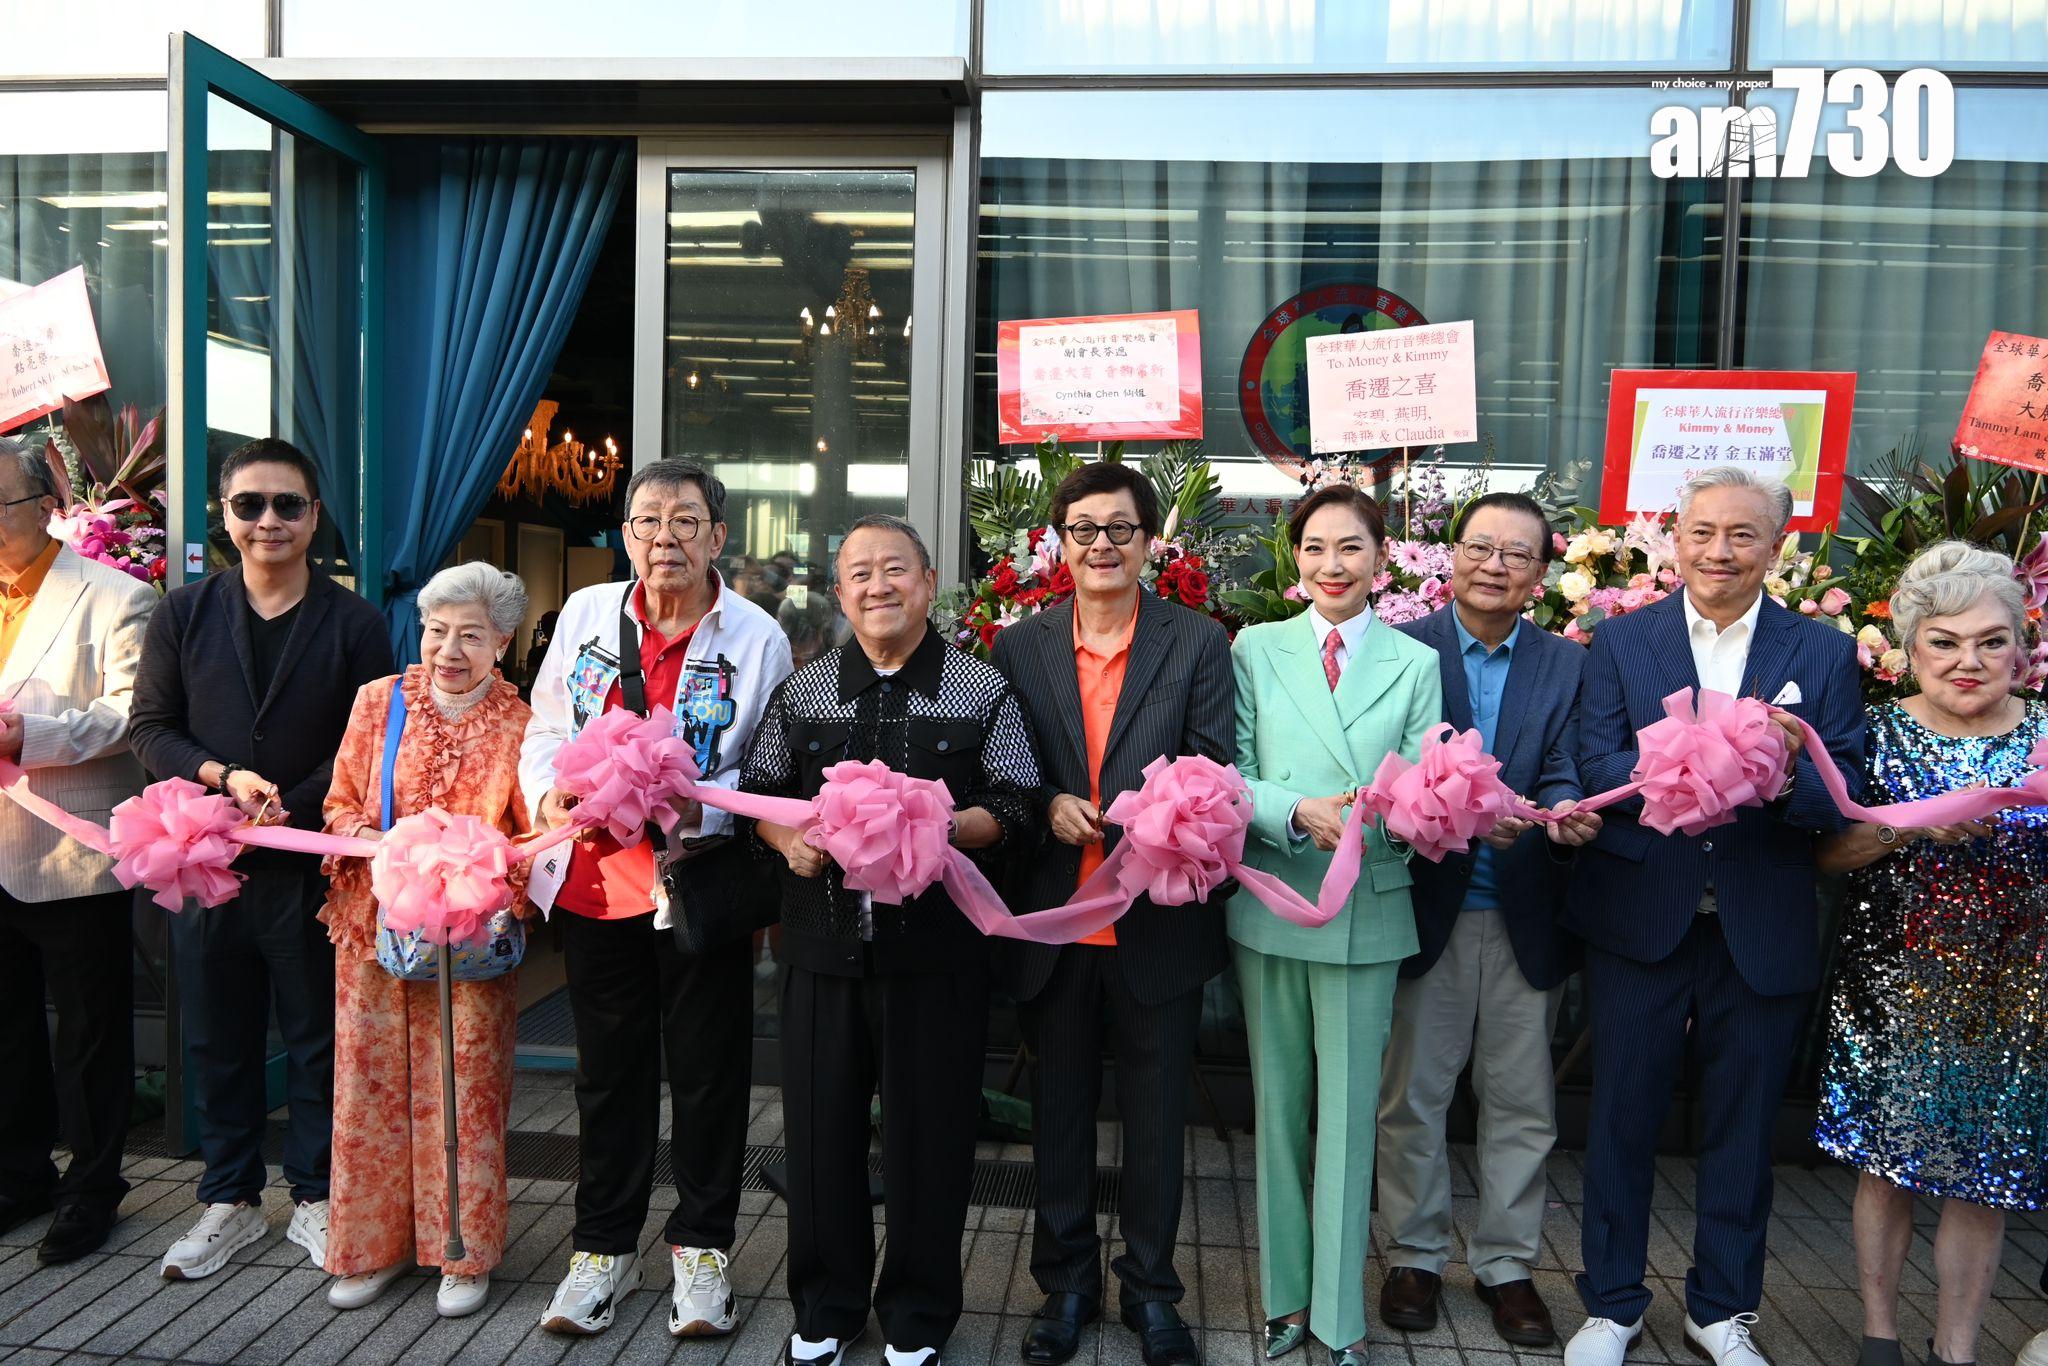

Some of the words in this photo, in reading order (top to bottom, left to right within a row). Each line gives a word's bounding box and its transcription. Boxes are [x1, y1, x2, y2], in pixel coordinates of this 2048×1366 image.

[1316, 329, 1460, 354] 全球華人流行音樂總會
[1348, 354, 1389, 369] Money
[1392, 353, 1402, 364] &
[1405, 350, 1449, 363] Kimmy
[1056, 389, 1092, 400] Cynthia
[1095, 390, 1119, 398] Chen
[1345, 373, 1437, 401] 喬遷之喜
[1379, 430, 1391, 443] &
[1395, 427, 1445, 442] Claudia
[1679, 423, 1720, 435] Kimmy
[1723, 423, 1732, 433] &
[1736, 423, 1775, 436] Money
[1969, 416, 2010, 435] Tammy
[2013, 425, 2041, 441] Lam
[1651, 444, 1719, 460] 喬遷之喜
[1726, 445, 1793, 462] 金玉滿堂
